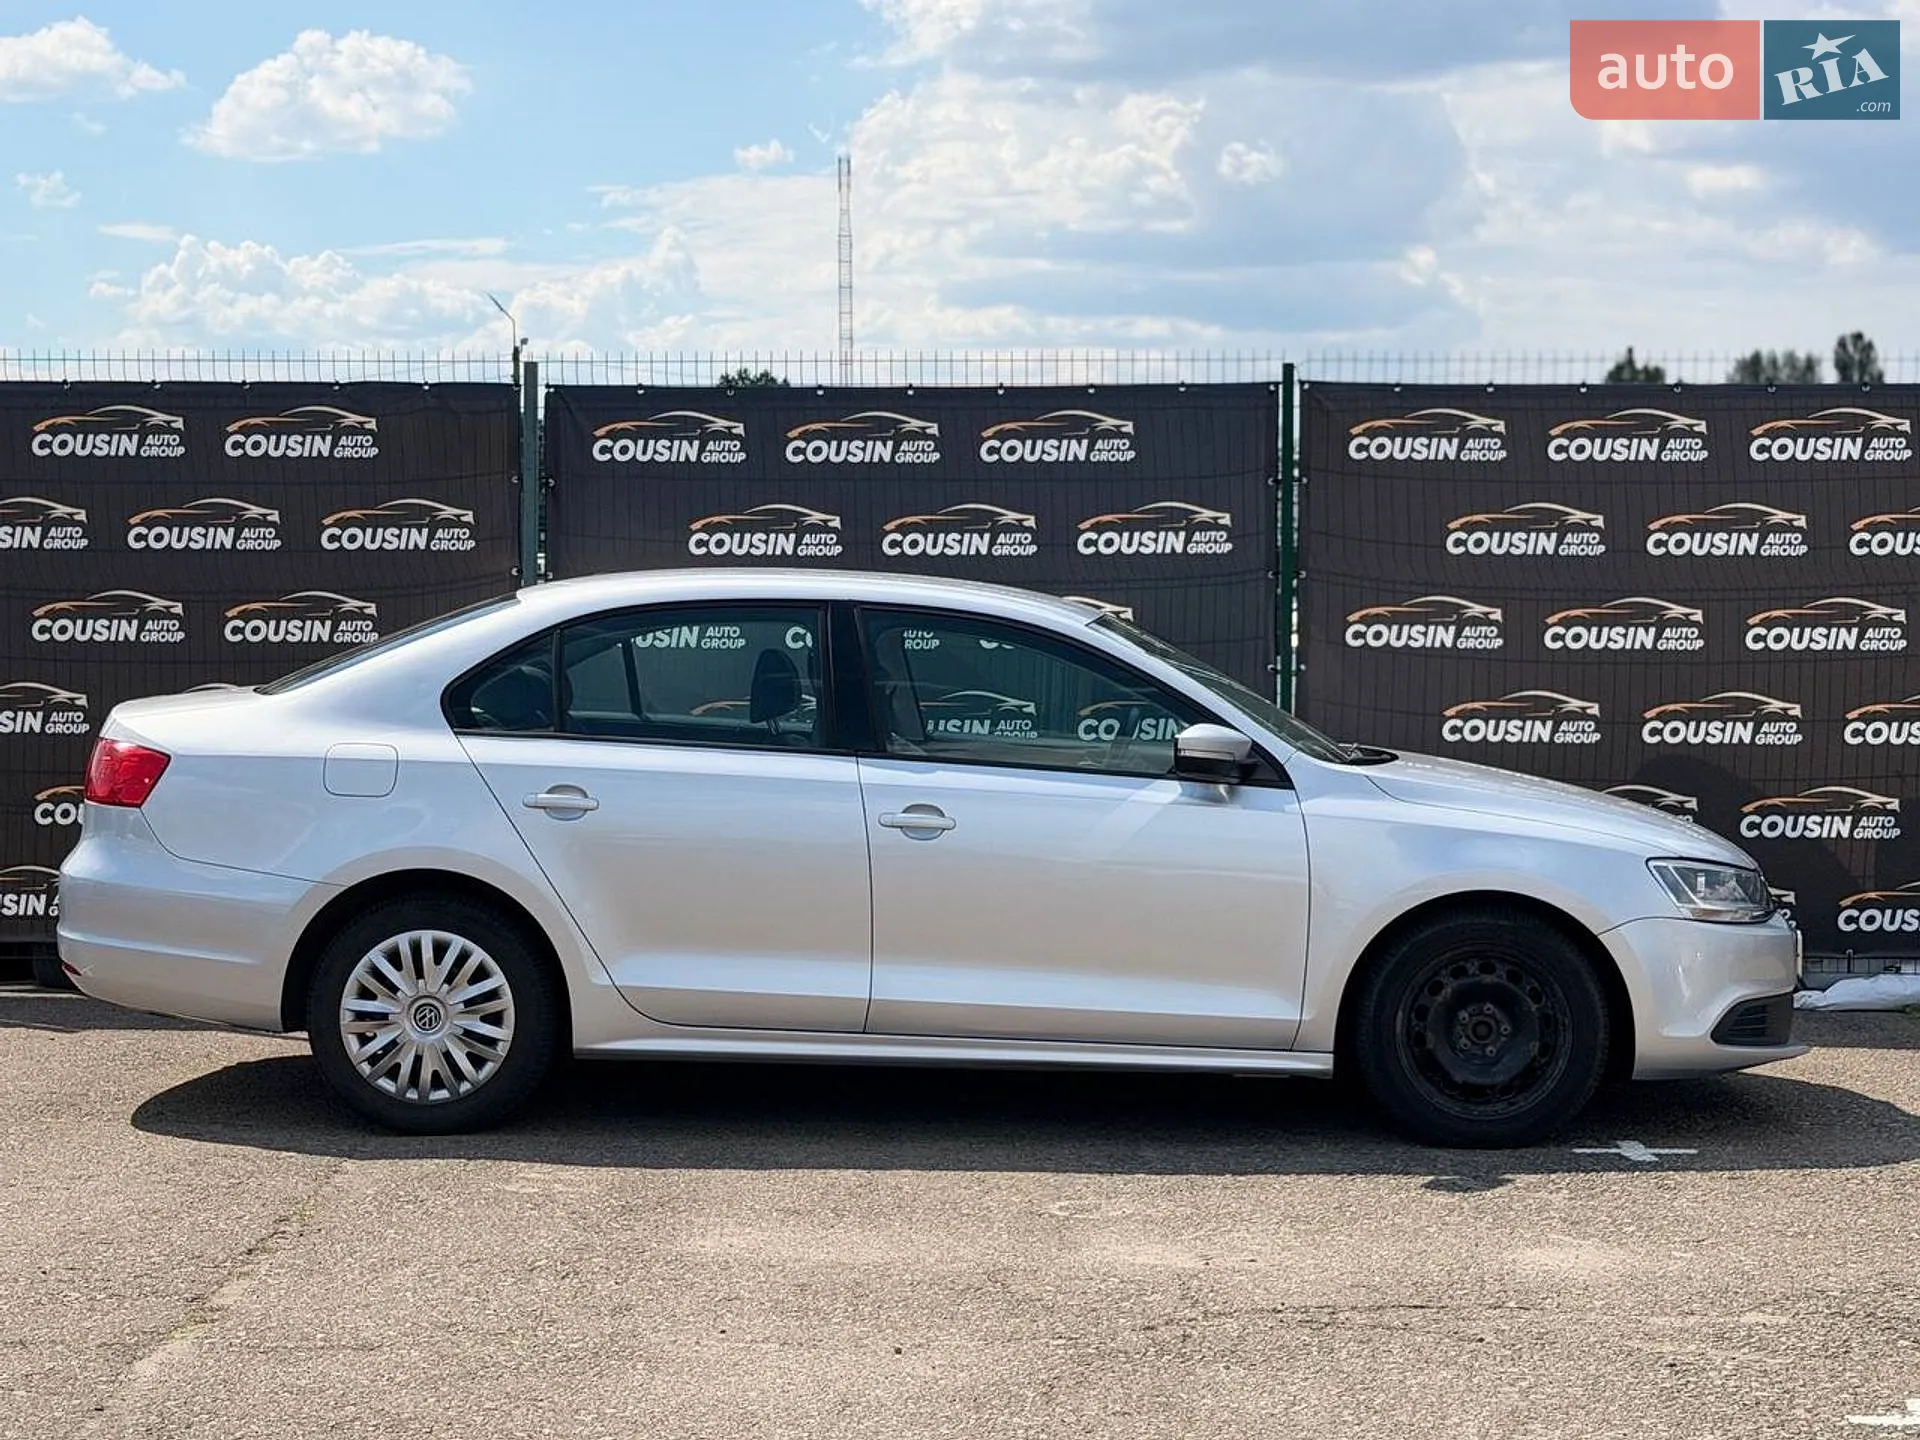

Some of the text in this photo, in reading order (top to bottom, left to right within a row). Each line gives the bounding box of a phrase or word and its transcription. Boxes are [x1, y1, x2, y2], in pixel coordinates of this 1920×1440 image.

[32, 433, 138, 457] COUSIN
[145, 434, 180, 446] AUTO
[225, 434, 332, 457] COUSIN
[338, 435, 373, 446] AUTO
[706, 440, 741, 451] AUTO
[900, 440, 934, 451] AUTO
[1095, 439, 1129, 449] AUTO
[1465, 438, 1501, 449] AUTO
[1665, 438, 1702, 449] AUTO
[1869, 438, 1906, 449] AUTO
[140, 446, 185, 457] GROUP
[334, 447, 379, 458] GROUP
[592, 439, 700, 462] COUSIN
[786, 440, 893, 463] COUSIN
[980, 439, 1088, 462] COUSIN
[1349, 437, 1459, 460] COUSIN
[1548, 437, 1659, 461] COUSIN
[1750, 437, 1863, 461] COUSIN
[701, 452, 746, 463] GROUP
[895, 452, 940, 463] GROUP
[1089, 450, 1136, 462] GROUP
[1460, 450, 1507, 461] GROUP
[1661, 450, 1708, 461] GROUP
[1864, 450, 1912, 461] GROUP
[0, 526, 42, 549] SIN
[48, 527, 83, 538] AUTO
[240, 528, 275, 538] AUTO
[435, 528, 470, 539] AUTO
[1192, 531, 1227, 542] AUTO
[43, 538, 88, 549] GROUP
[127, 527, 235, 550] COUSIN
[321, 527, 428, 550] COUSIN
[688, 532, 796, 556] COUSIN
[802, 534, 837, 544] AUTO
[997, 533, 1031, 544] AUTO
[1077, 531, 1185, 554] COUSIN
[1446, 531, 1557, 555] COUSIN
[1563, 533, 1599, 544] AUTO
[1646, 532, 1759, 556] COUSIN
[1765, 533, 1802, 544] AUTO
[236, 539, 282, 550] GROUP
[430, 540, 475, 551] GROUP
[882, 533, 990, 556] COUSIN
[1186, 543, 1232, 554] GROUP
[797, 545, 842, 556] GROUP
[991, 545, 1037, 556] GROUP
[1558, 545, 1606, 556] GROUP
[1760, 545, 1808, 556] GROUP
[32, 618, 138, 642] COUSIN
[145, 620, 180, 631] AUTO
[224, 619, 332, 642] COUSIN
[338, 620, 373, 631] AUTO
[140, 631, 185, 643] GROUP
[706, 627, 740, 637] AUTO
[1345, 624, 1455, 648] COUSIN
[1461, 626, 1498, 637] AUTO
[1662, 627, 1698, 638] AUTO
[1864, 627, 1901, 638] AUTO
[333, 632, 379, 643] GROUP
[1456, 637, 1504, 649] GROUP
[1544, 626, 1655, 650] COUSIN
[1745, 627, 1858, 650] COUSIN
[701, 639, 745, 649] GROUP
[905, 639, 940, 649] ROUP
[1657, 639, 1704, 650] GROUP
[1859, 639, 1907, 650] GROUP
[0, 710, 43, 733] SIN
[50, 711, 84, 722] AUTO
[45, 723, 90, 734] GROUP
[996, 719, 1032, 730] AUTO
[1559, 721, 1595, 732] AUTO
[1760, 722, 1797, 733] AUTO
[1442, 719, 1553, 743] COUSIN
[1642, 721, 1753, 744] COUSIN
[1844, 721, 1920, 745] COUS
[1554, 732, 1601, 744] GROUP
[1755, 734, 1802, 745] GROUP
[1740, 815, 1853, 839] COUSIN
[1858, 816, 1895, 827] AUTO
[1853, 828, 1900, 840] GROUP
[0, 893, 46, 916] SIN
[1837, 908, 1920, 932] COUS
